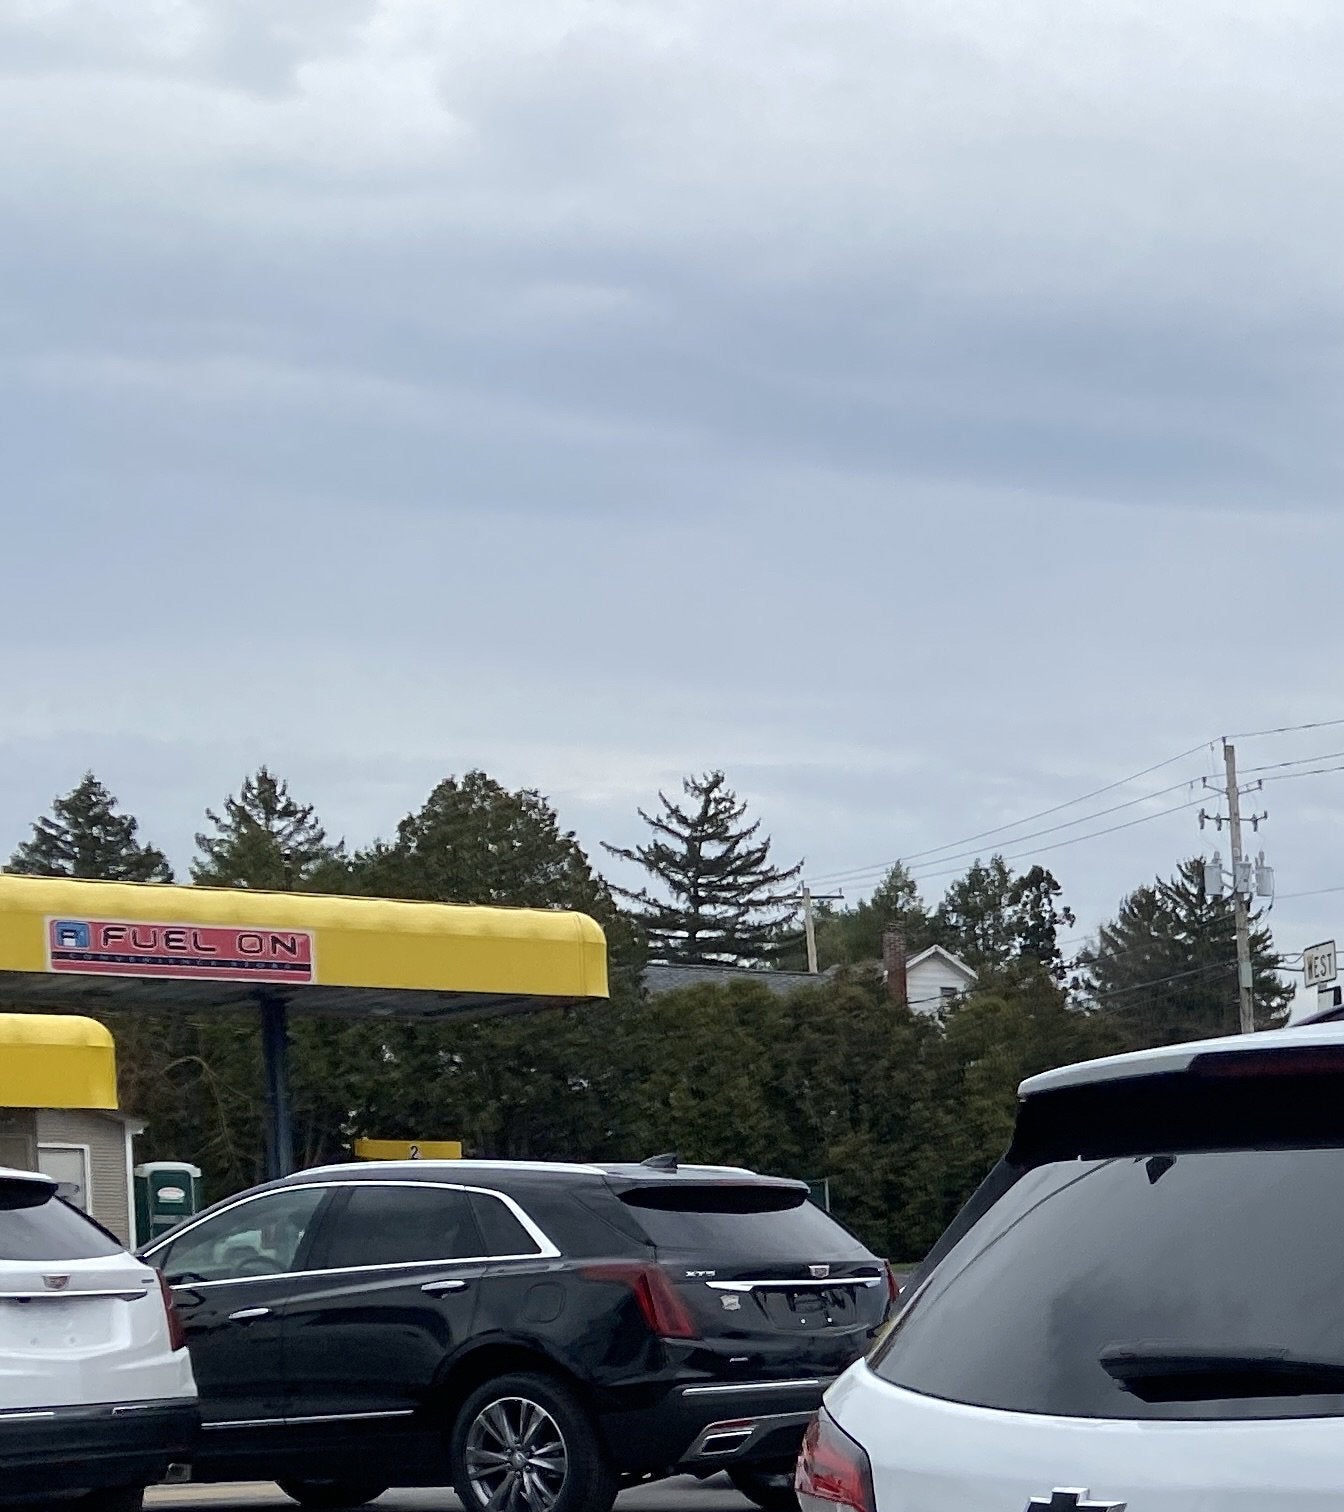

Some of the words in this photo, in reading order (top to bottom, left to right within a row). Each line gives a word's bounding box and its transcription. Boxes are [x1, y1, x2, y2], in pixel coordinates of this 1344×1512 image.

[101, 926, 217, 952] FUEL
[237, 933, 298, 956] ON
[1306, 952, 1333, 980] WEST
[410, 1145, 420, 1160] 2
